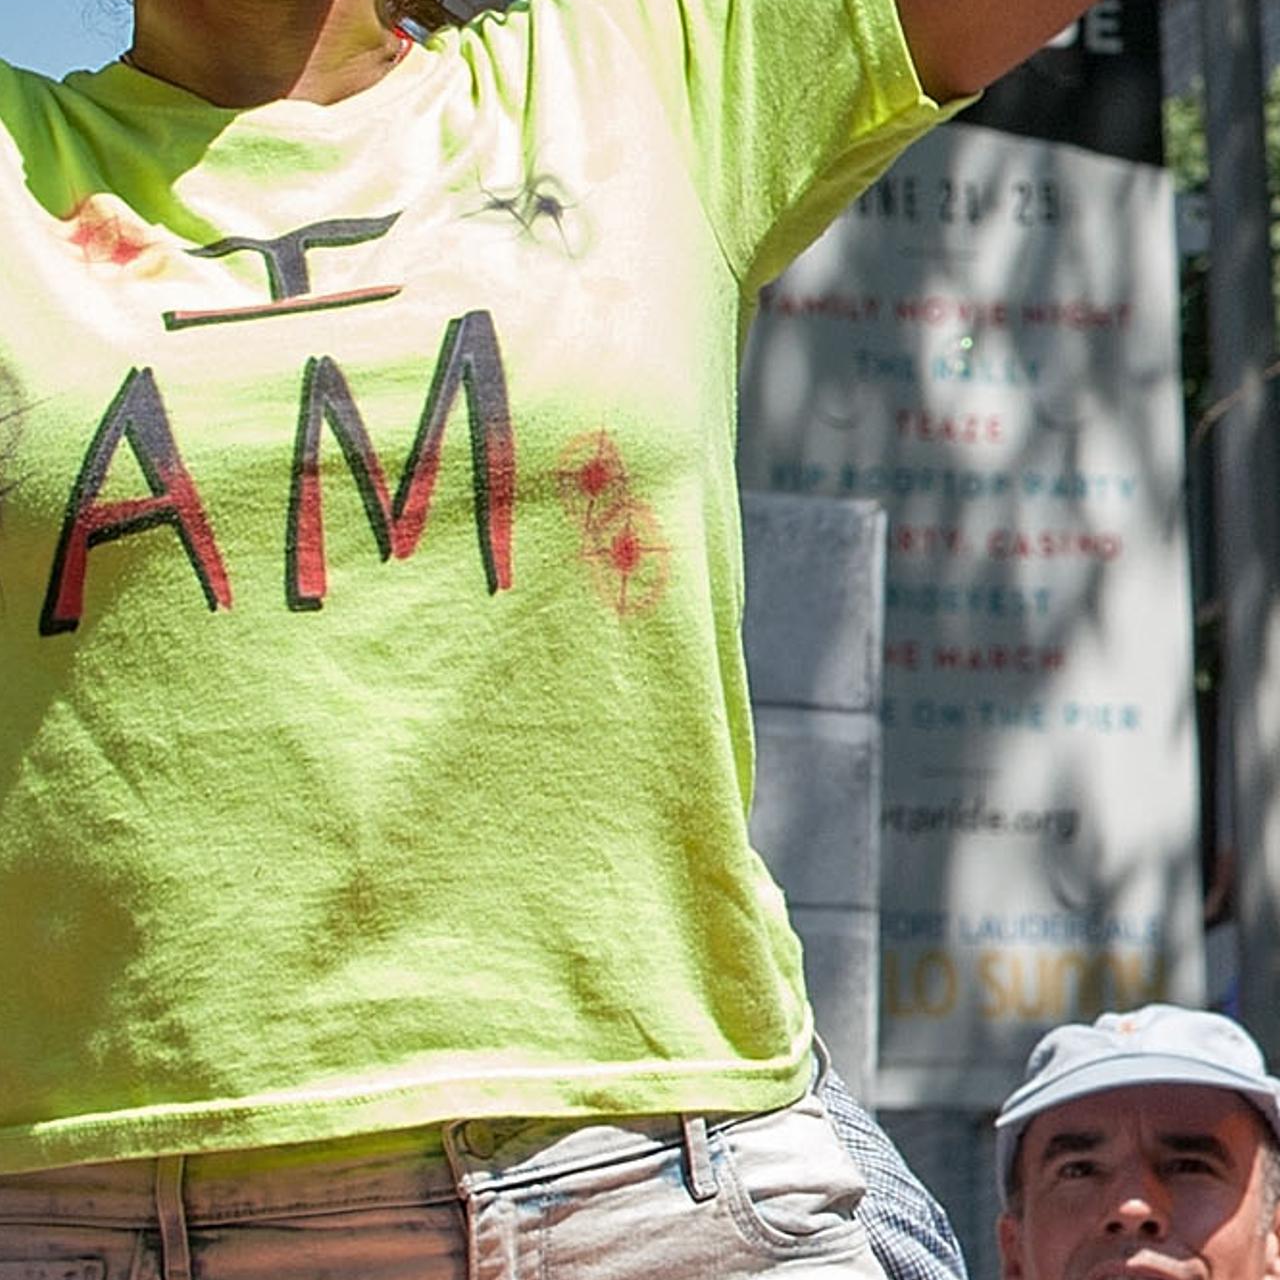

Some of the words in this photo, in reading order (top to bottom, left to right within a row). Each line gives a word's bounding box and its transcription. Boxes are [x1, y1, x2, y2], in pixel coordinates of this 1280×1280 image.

[162, 210, 404, 331] I
[39, 309, 517, 637] AM
[986, 530, 1123, 563] CASINO
[934, 644, 1067, 673] MARCH
[1063, 702, 1140, 732] PIER
